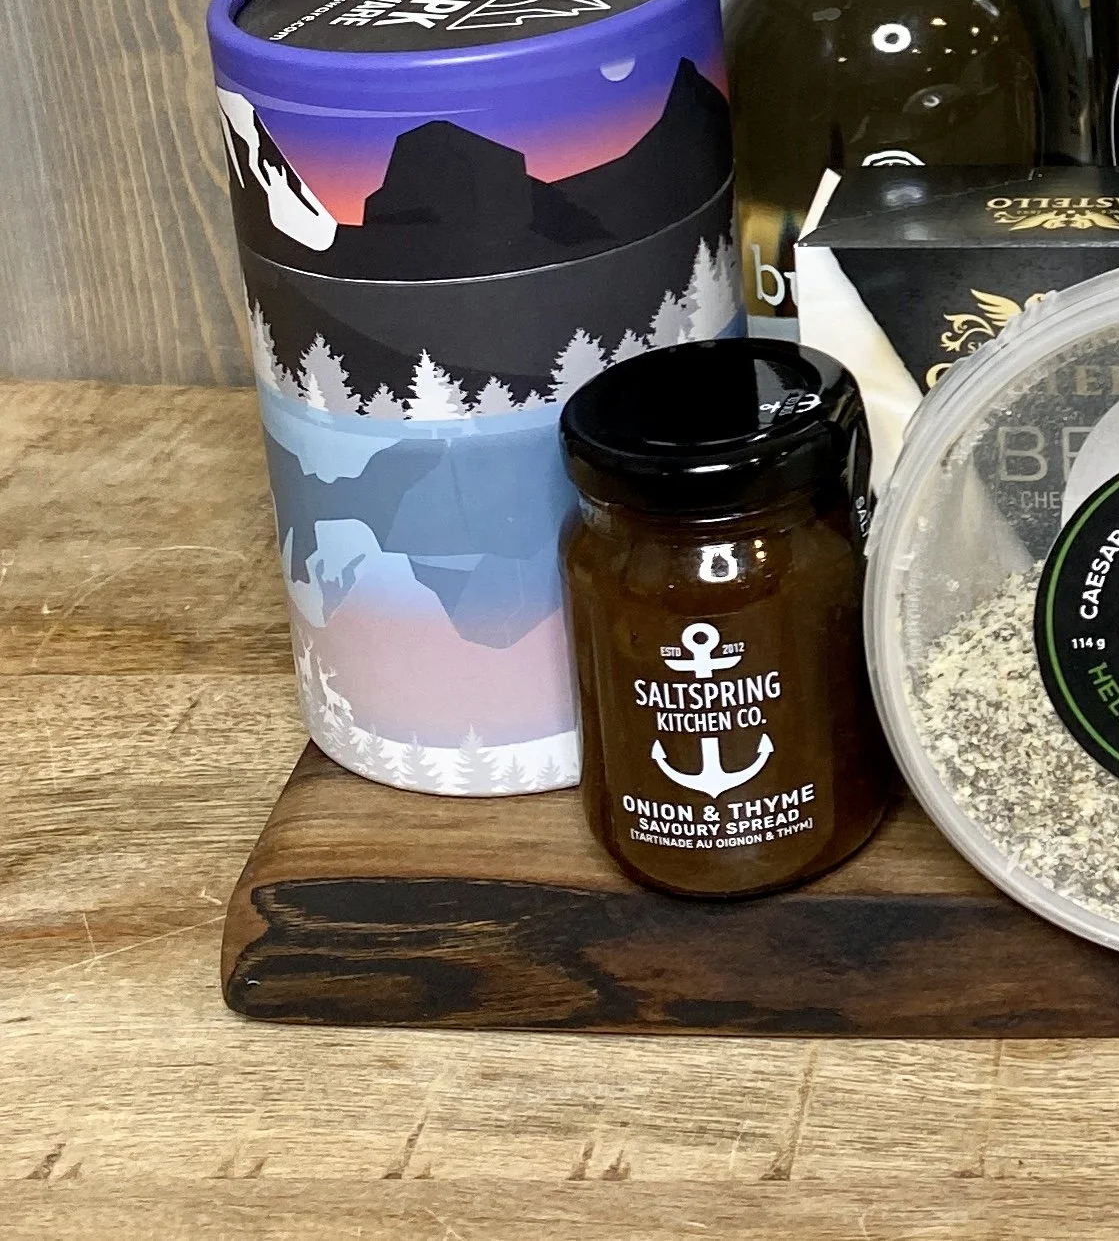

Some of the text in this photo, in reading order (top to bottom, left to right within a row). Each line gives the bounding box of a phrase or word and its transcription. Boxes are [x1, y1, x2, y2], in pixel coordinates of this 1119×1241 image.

[722, 642, 746, 655] 2012
[1072, 638, 1105, 650] 114 g
[634, 671, 782, 710] SALTSPRING
[656, 706, 767, 733] KITCHEN CO.
[622, 784, 816, 822] ONION & THYME
[638, 809, 800, 837] SAVOURY SPREAD
[695, 839, 713, 849] AU
[718, 835, 763, 849] OIGNON
[765, 832, 775, 841] &
